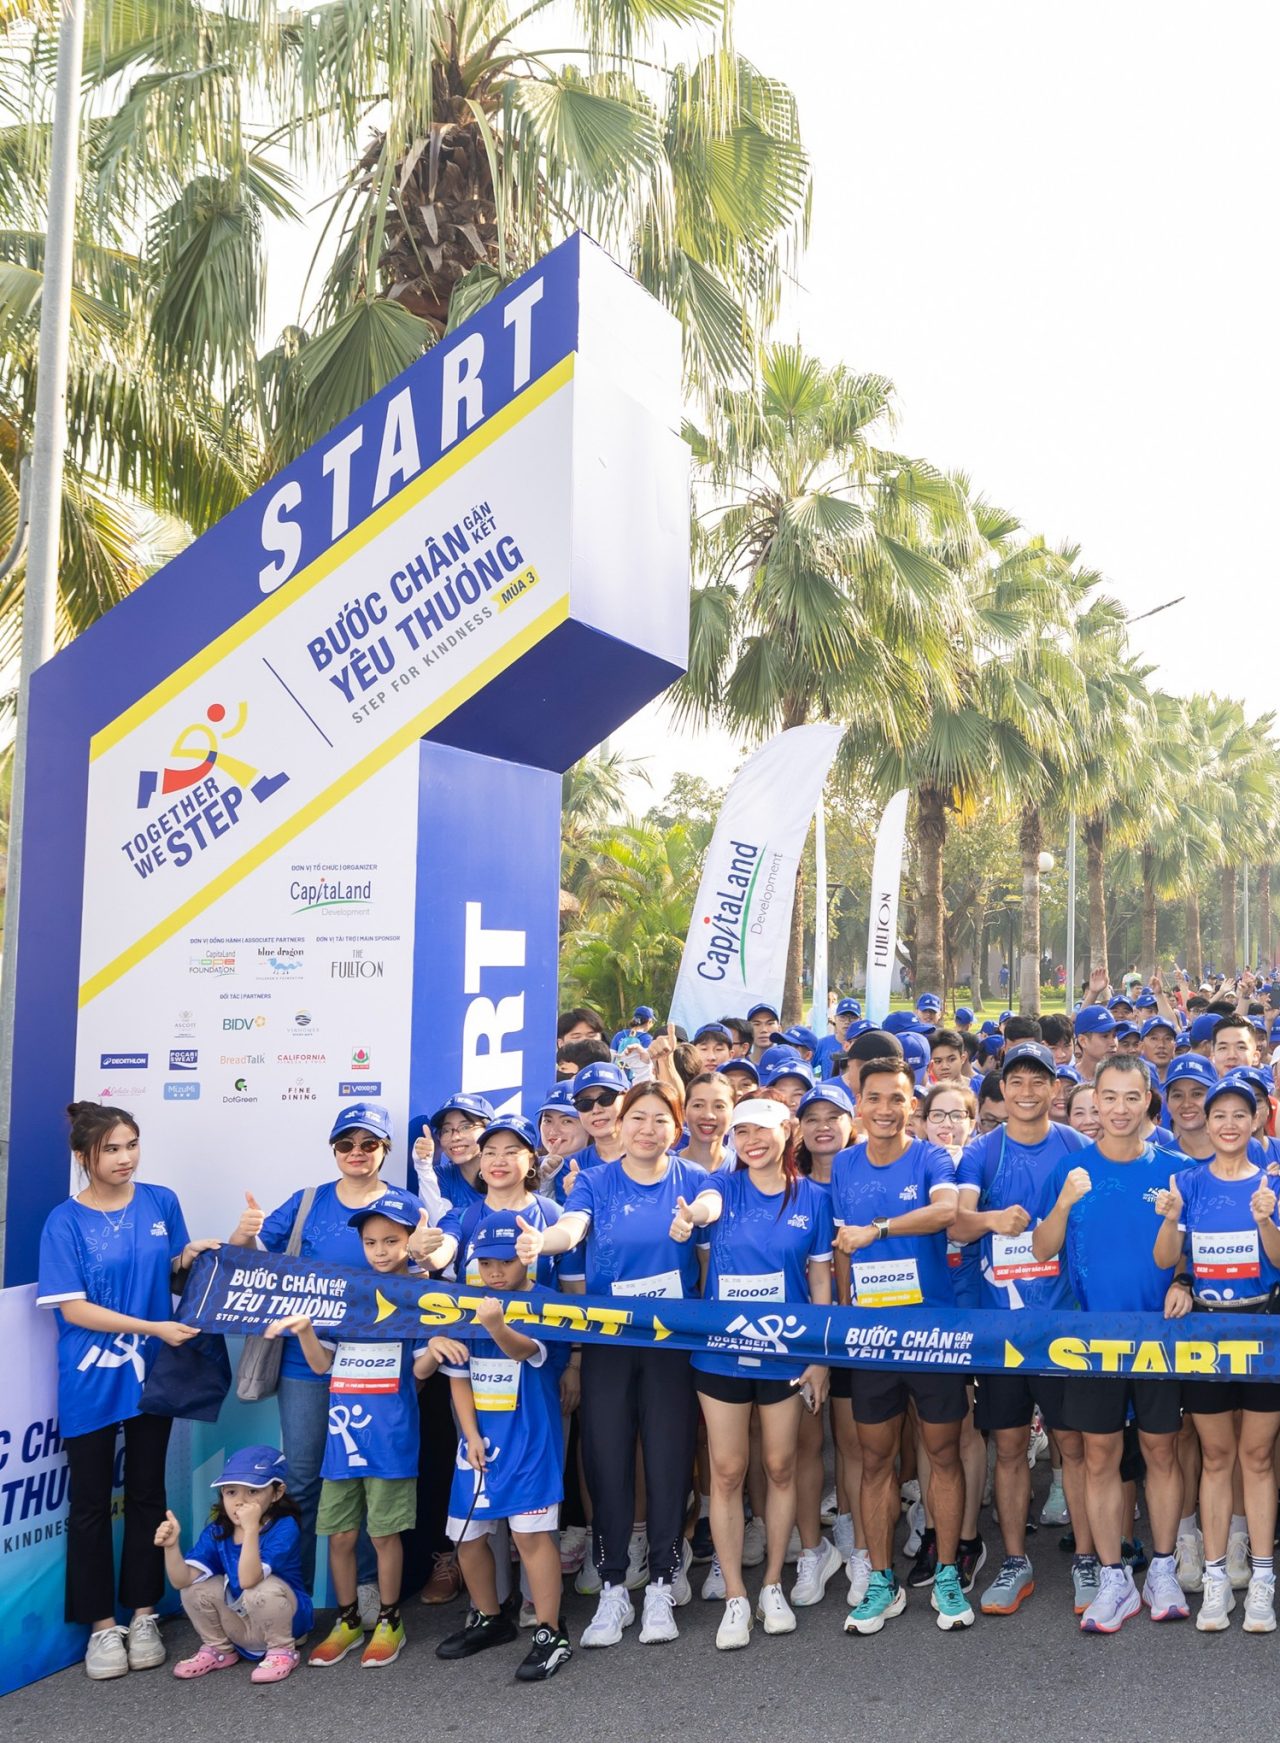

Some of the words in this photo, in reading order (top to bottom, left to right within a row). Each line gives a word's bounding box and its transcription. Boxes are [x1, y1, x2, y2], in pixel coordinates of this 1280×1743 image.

[258, 277, 543, 594] START
[471, 517, 497, 544] KẾT
[306, 591, 388, 672] BƯỚC
[389, 524, 471, 604] CHÂN
[501, 580, 526, 604] MÙA
[528, 571, 536, 584] 3
[329, 636, 395, 704] YÊU
[395, 535, 524, 651] THƯƠNG
[352, 691, 386, 724] STEP
[391, 665, 420, 692] FOR
[422, 606, 493, 667] KINDNESS
[121, 776, 220, 862] TOGETHER
[134, 845, 167, 879] WE
[166, 786, 243, 868] STEP
[290, 878, 371, 905] CapitaLand
[751, 853, 783, 935] Development
[321, 908, 370, 917] Development
[697, 840, 758, 981] CapitaLand
[258, 947, 275, 956] blue
[277, 947, 304, 957] dragon
[352, 949, 363, 958] THE
[331, 960, 384, 979] FULLTON
[223, 1018, 254, 1031] BIDV
[220, 1055, 265, 1065] BreadTalk
[223, 1096, 258, 1104] DotGreen
[1198, 1245, 1254, 1255] 5A0586
[229, 1267, 278, 1290] BƯỚC
[281, 1273, 330, 1295] CHÂN
[861, 1272, 915, 1285] 002025
[223, 1288, 265, 1312] YÊU
[267, 1295, 347, 1319] THƯƠNG
[216, 1313, 239, 1322] STEP
[242, 1316, 260, 1324] FOR
[845, 1325, 896, 1347] BƯỚC
[901, 1327, 954, 1349] CHÂN
[339, 1358, 396, 1367] 5F0022
[1048, 1337, 1263, 1375] START
